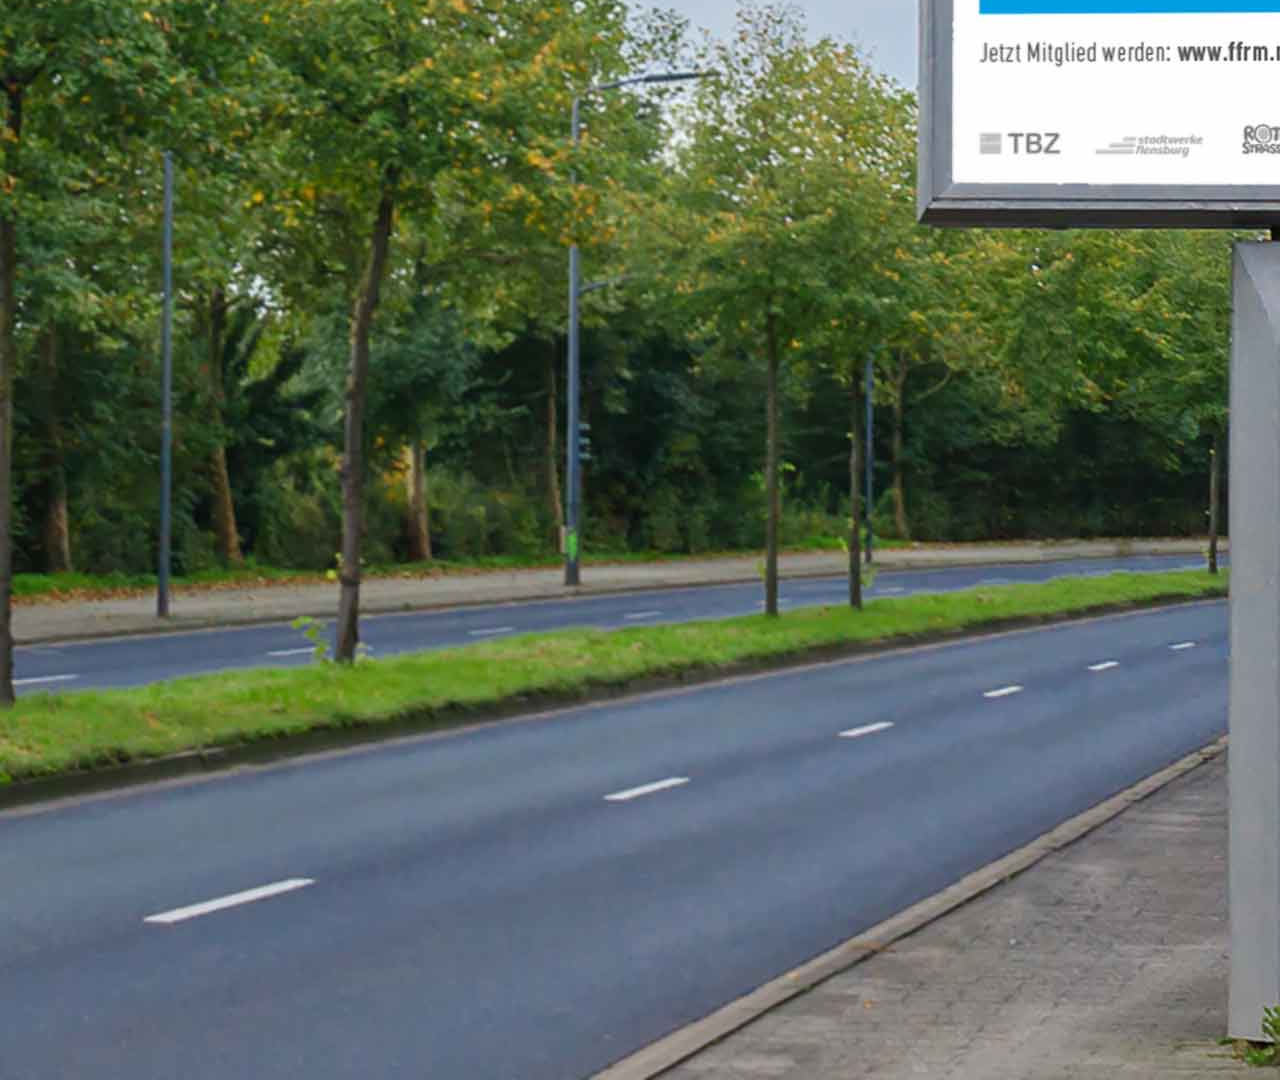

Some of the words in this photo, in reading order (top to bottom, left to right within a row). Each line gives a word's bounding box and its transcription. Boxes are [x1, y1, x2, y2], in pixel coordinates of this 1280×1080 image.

[979, 42, 1021, 63] Jetzt
[1027, 42, 1097, 67] Mitglied
[1102, 42, 1171, 62] werden:
[1008, 133, 1061, 154] TBZ
